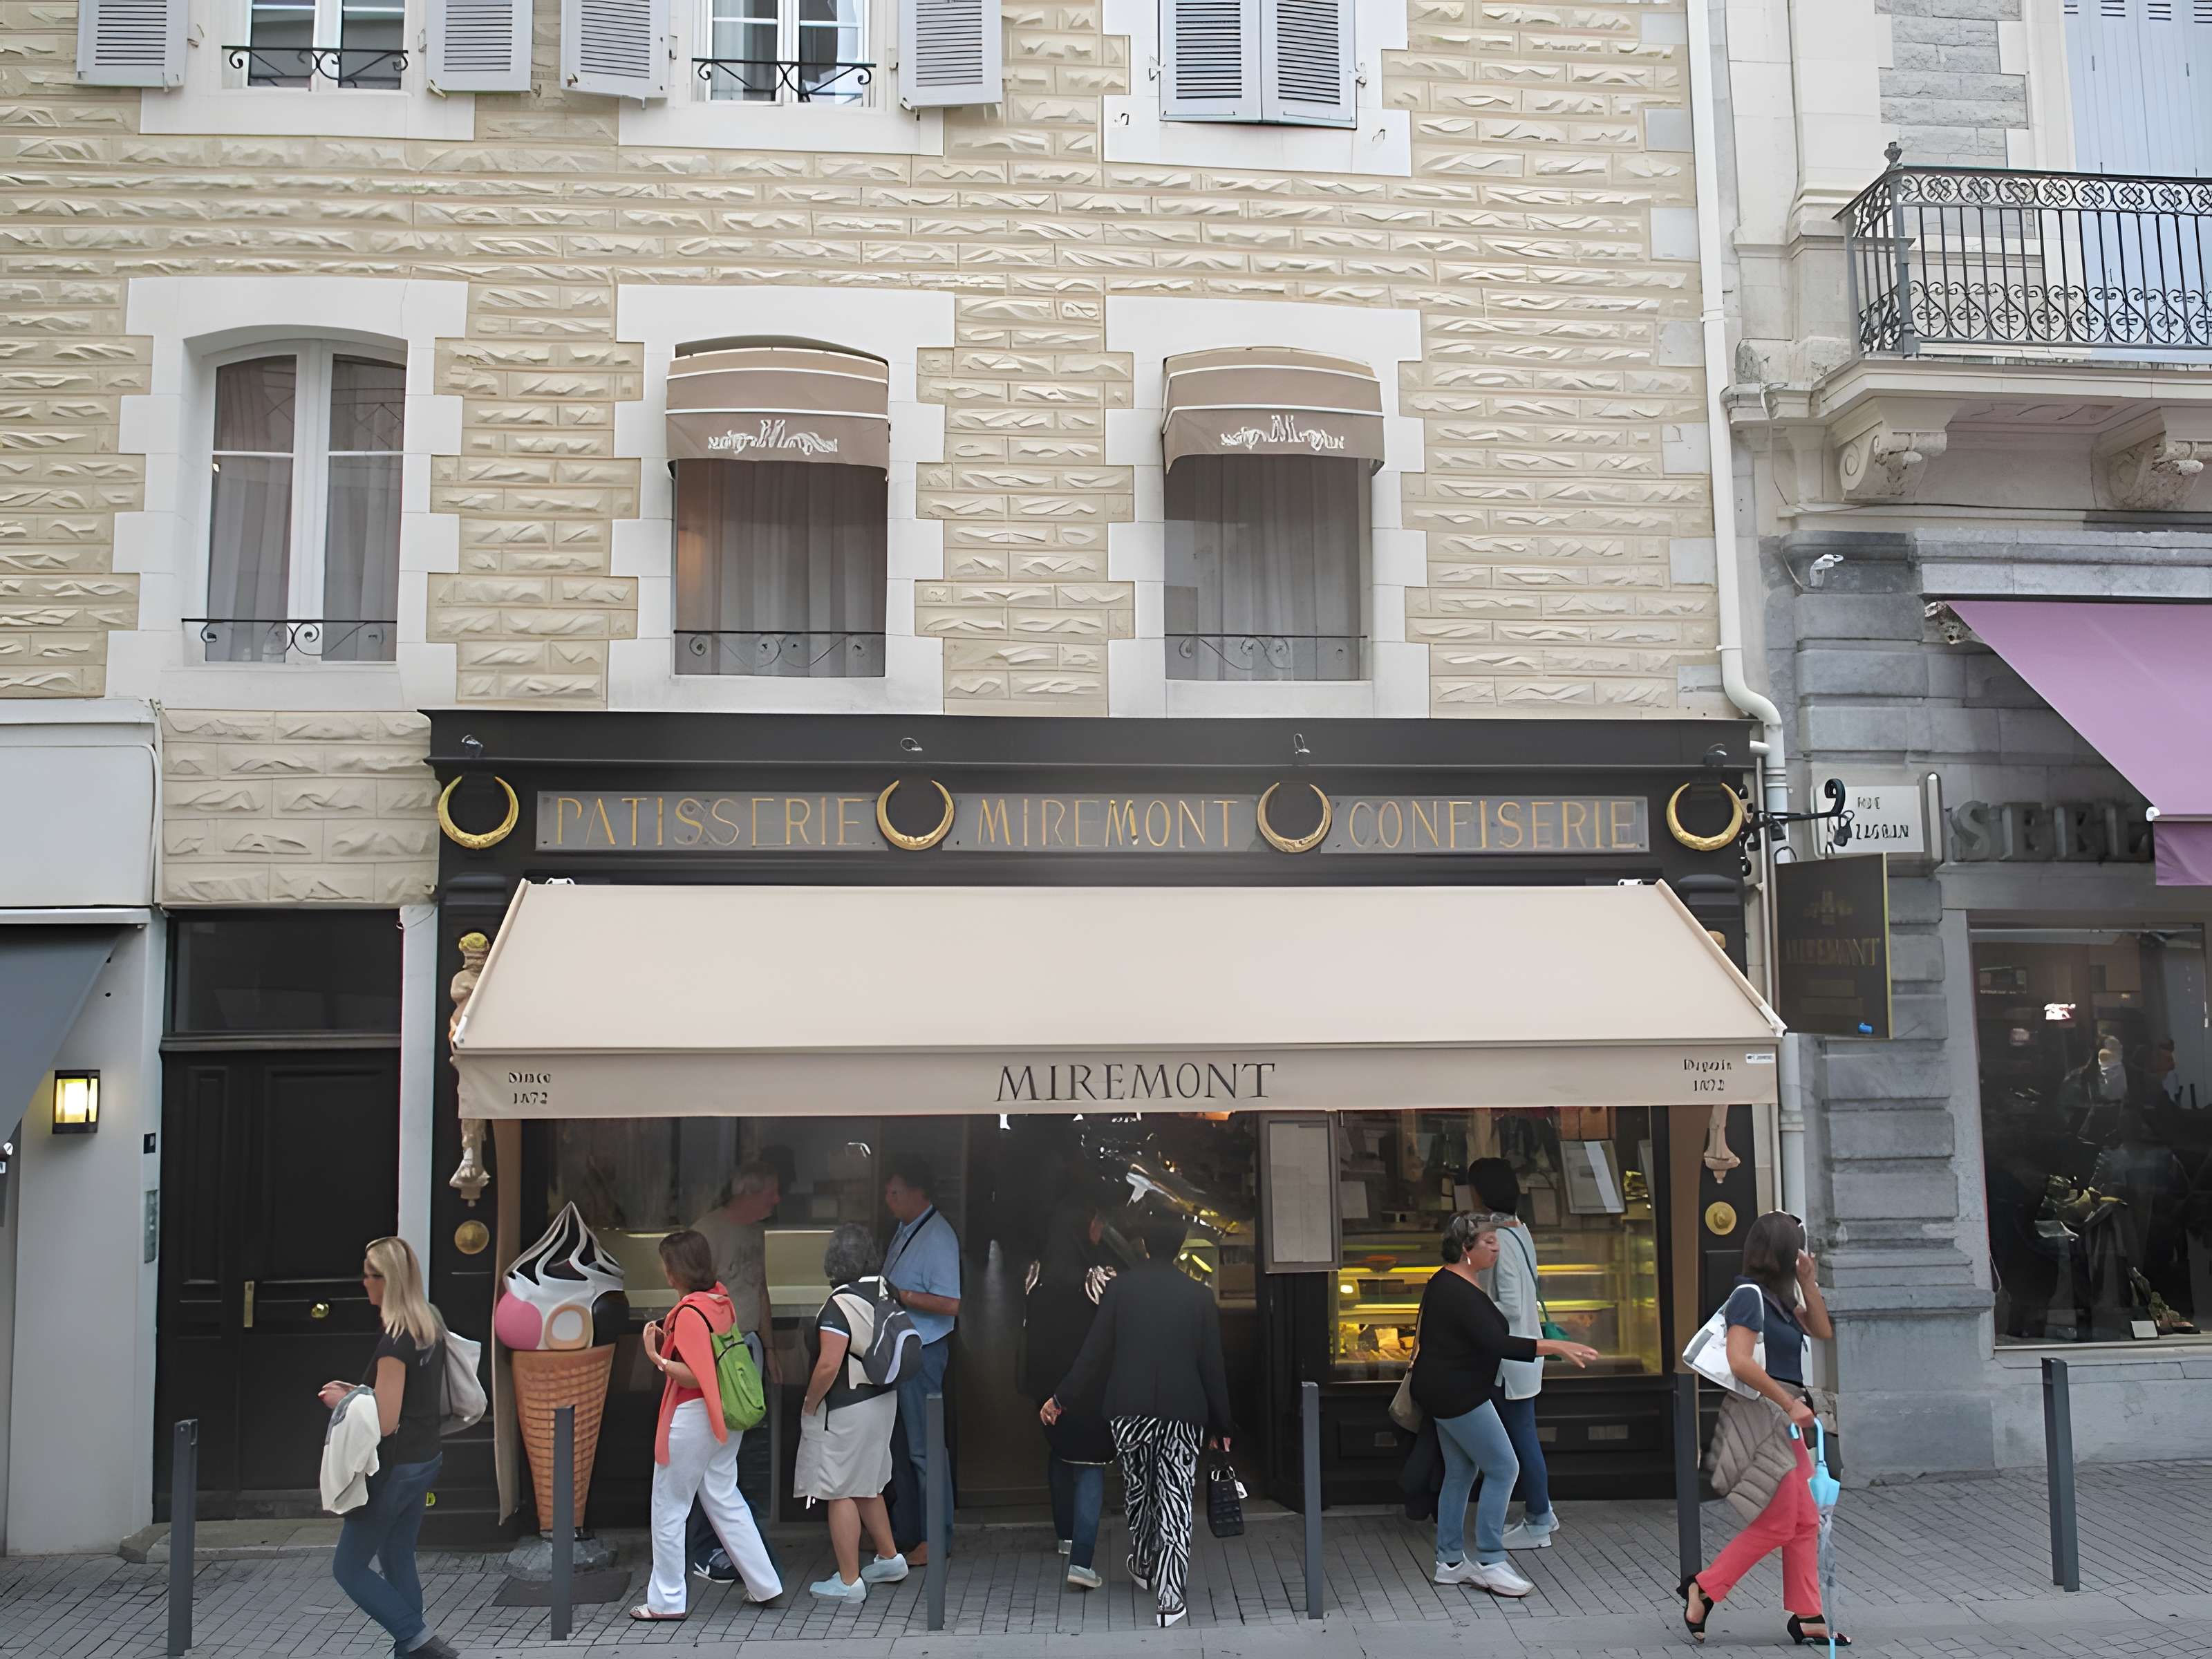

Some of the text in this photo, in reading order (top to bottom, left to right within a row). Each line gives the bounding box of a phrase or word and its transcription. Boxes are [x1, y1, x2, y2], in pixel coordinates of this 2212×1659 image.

[557, 797, 863, 847] PATISSERIE
[977, 798, 1238, 848] MIREMONT
[1349, 800, 1638, 849] CONFISERIE
[996, 1062, 1275, 1102] MIREMONT
